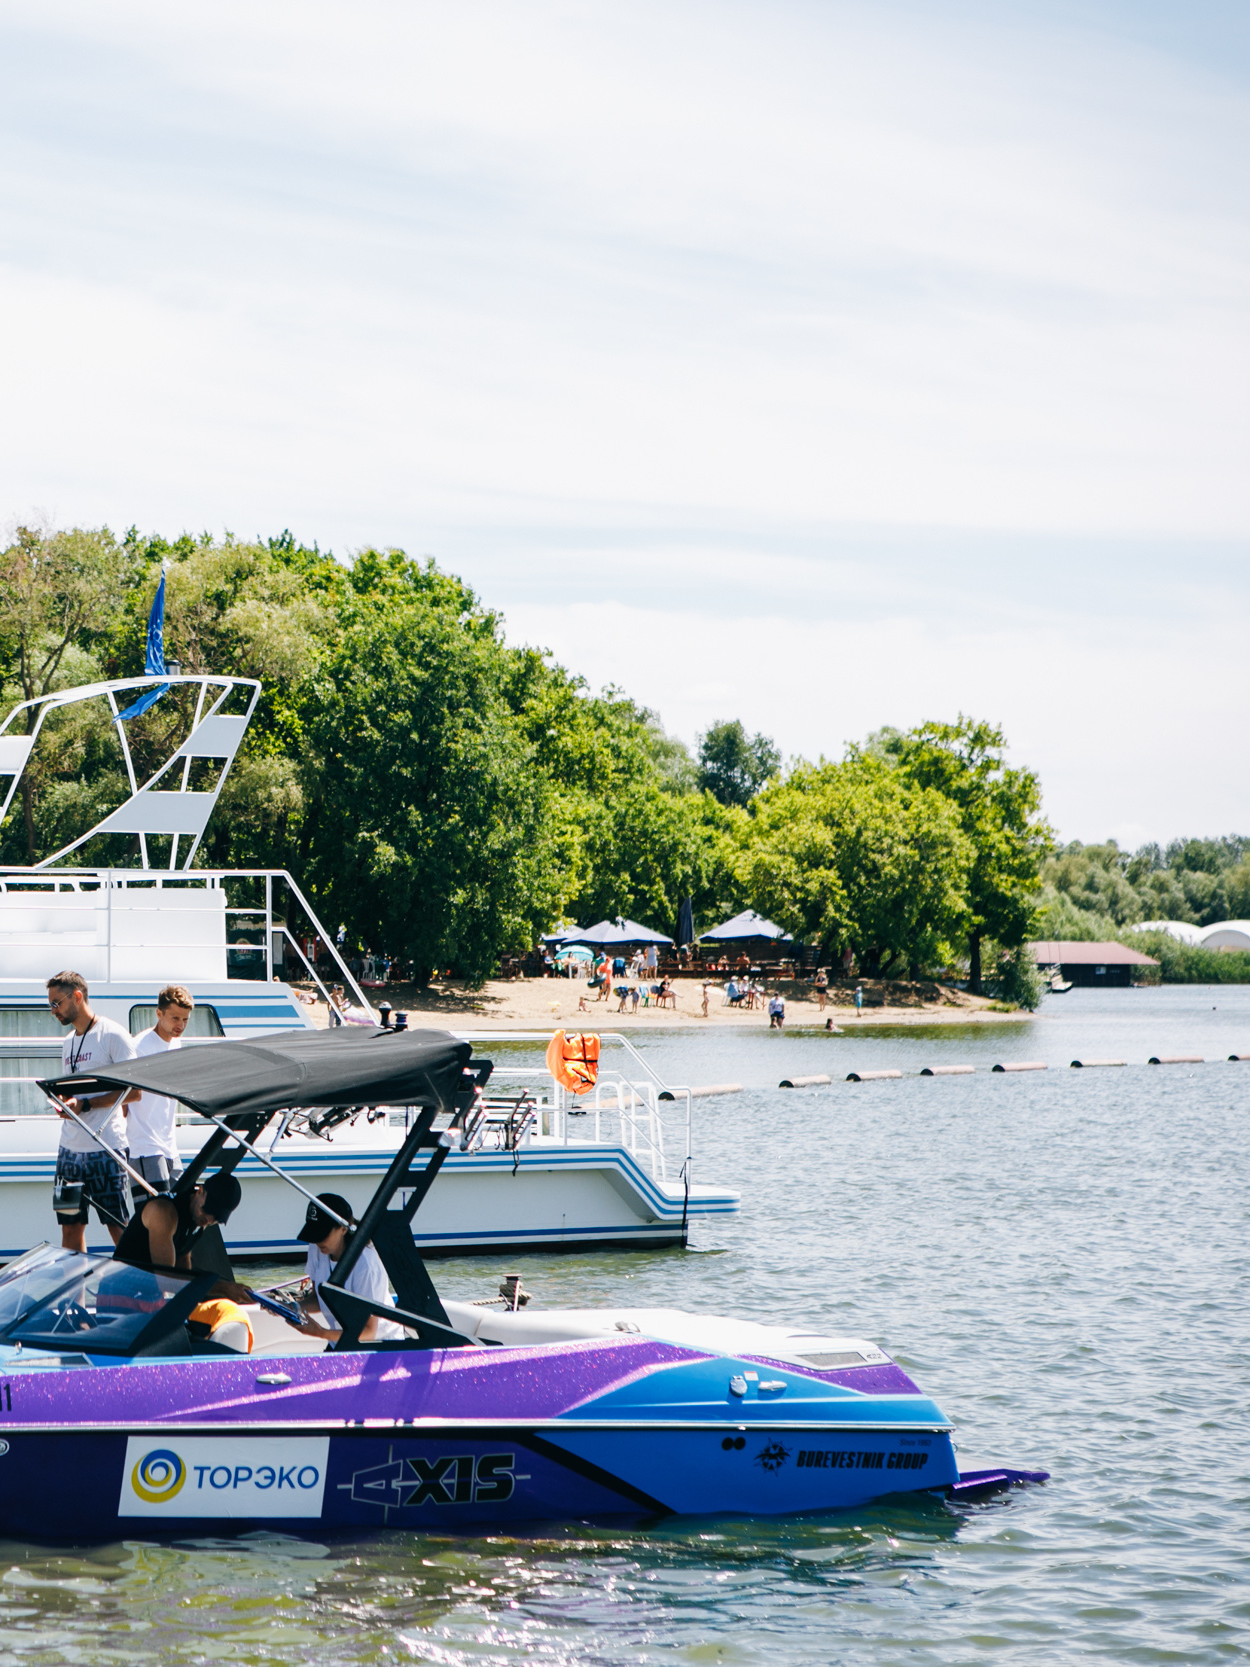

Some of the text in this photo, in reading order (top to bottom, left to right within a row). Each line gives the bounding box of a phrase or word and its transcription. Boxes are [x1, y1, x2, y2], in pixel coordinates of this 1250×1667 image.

[796, 1450, 929, 1470] BUREVESTNIK GROUP
[193, 1465, 320, 1490] ТОРЭКО
[351, 1453, 516, 1509] AXIS
